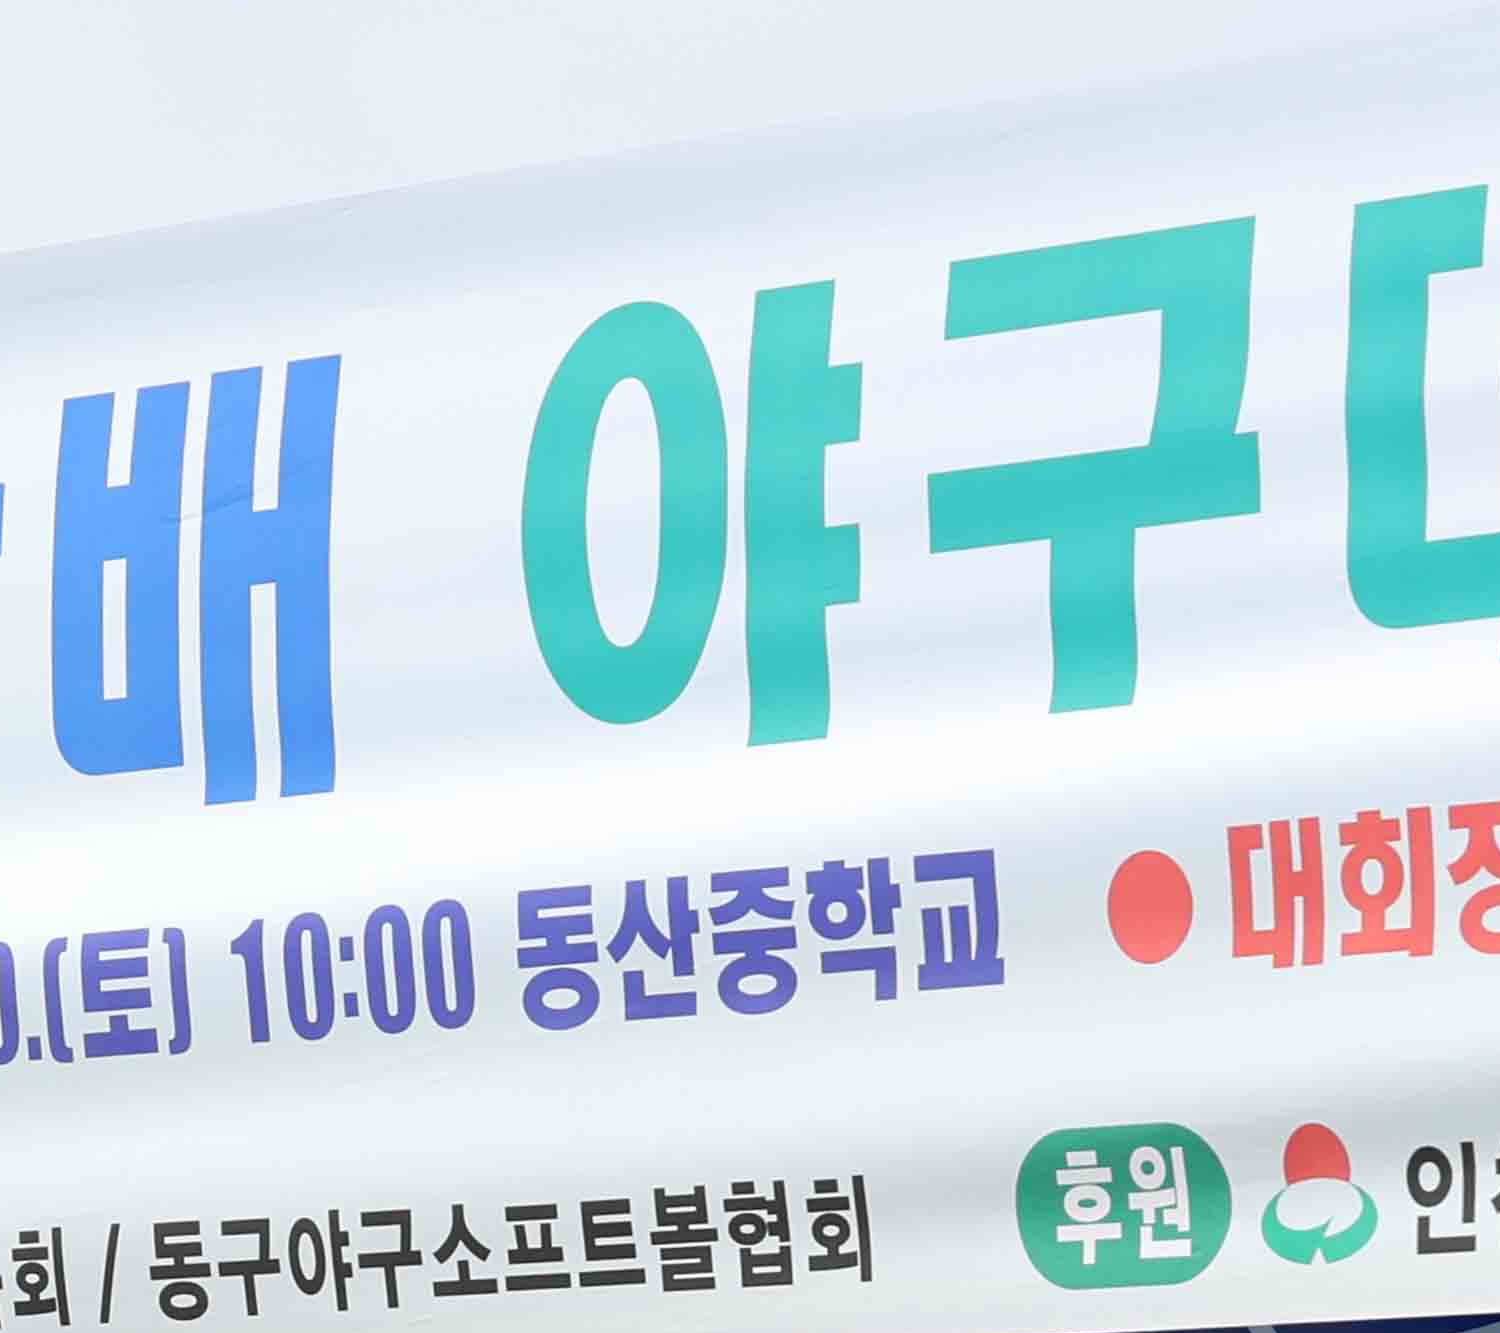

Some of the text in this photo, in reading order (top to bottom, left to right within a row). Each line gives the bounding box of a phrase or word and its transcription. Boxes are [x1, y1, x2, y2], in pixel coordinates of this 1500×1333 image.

[231, 900, 474, 1041] 10:00
[519, 850, 1005, 1031] 동산중학교
[149, 1175, 873, 1321] 동구야구소프트볼협회
[1054, 1143, 1193, 1264] 후원
